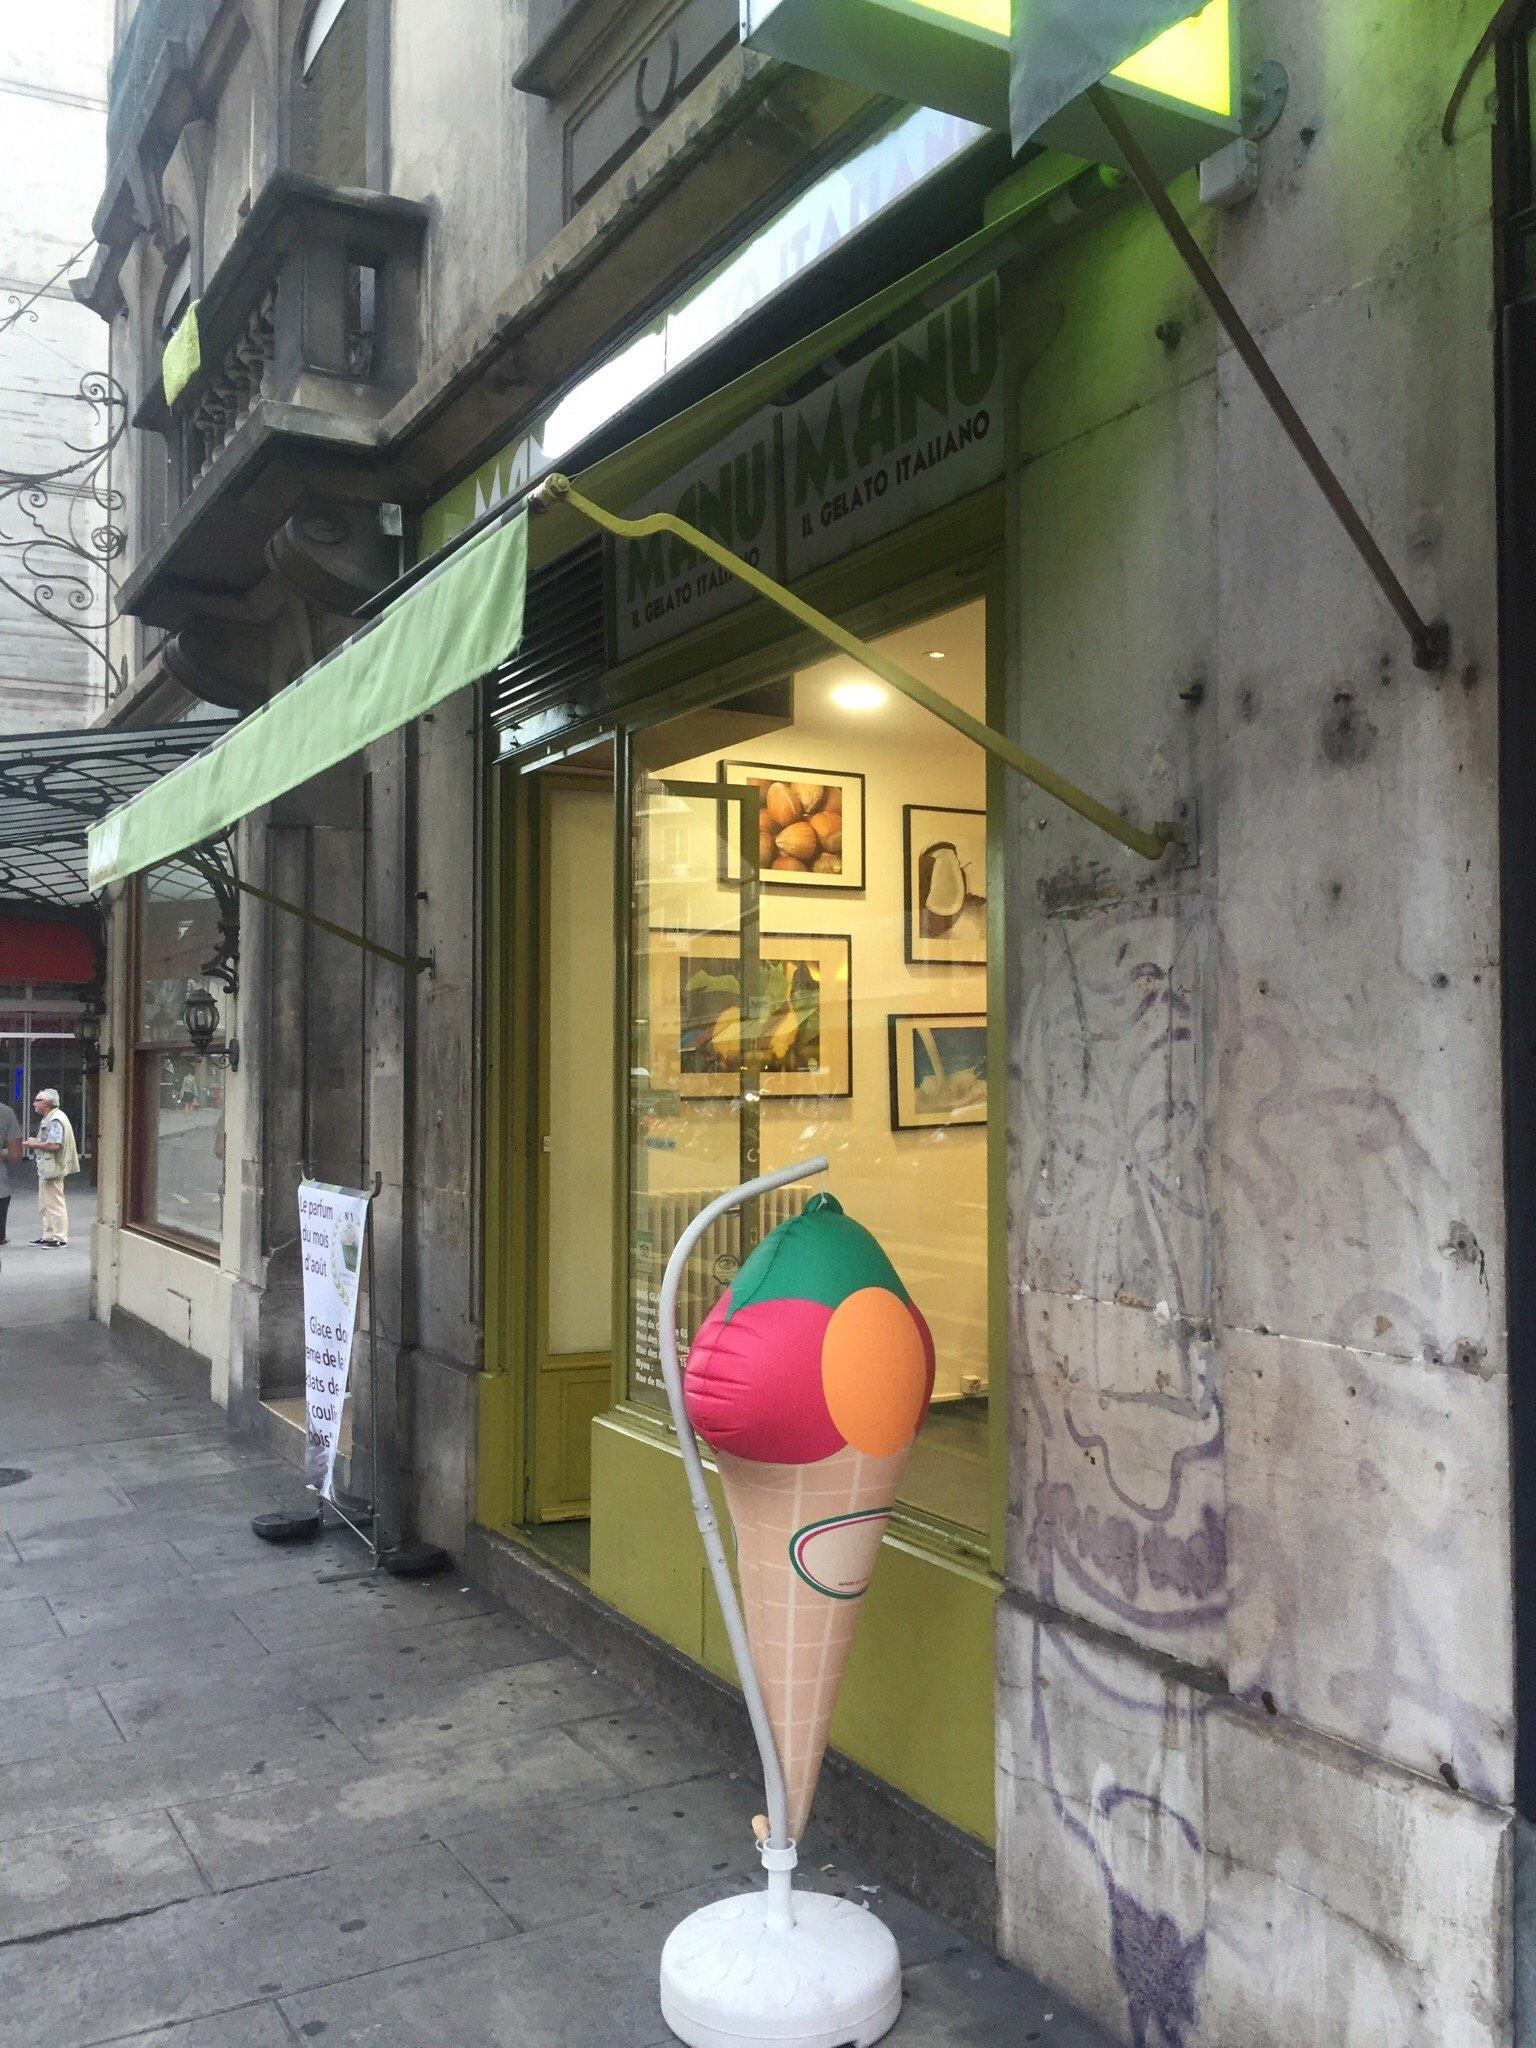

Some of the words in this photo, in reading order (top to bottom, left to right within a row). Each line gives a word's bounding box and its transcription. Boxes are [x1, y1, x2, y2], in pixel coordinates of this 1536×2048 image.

[795, 273, 998, 506] MANU
[802, 513, 814, 538] IL
[821, 469, 888, 527] GELATO
[896, 410, 990, 485] ITALIANO
[627, 439, 767, 603] MANU
[645, 582, 692, 623] GELATO
[696, 546, 760, 598] ITALIO
[300, 1196, 307, 1214] Le
[308, 1198, 334, 1220] parfum
[302, 1225, 312, 1243] du
[312, 1229, 329, 1248] mois
[304, 1251, 327, 1277] d'août
[309, 1316, 332, 1339] Glace
[322, 1348, 336, 1368] de
